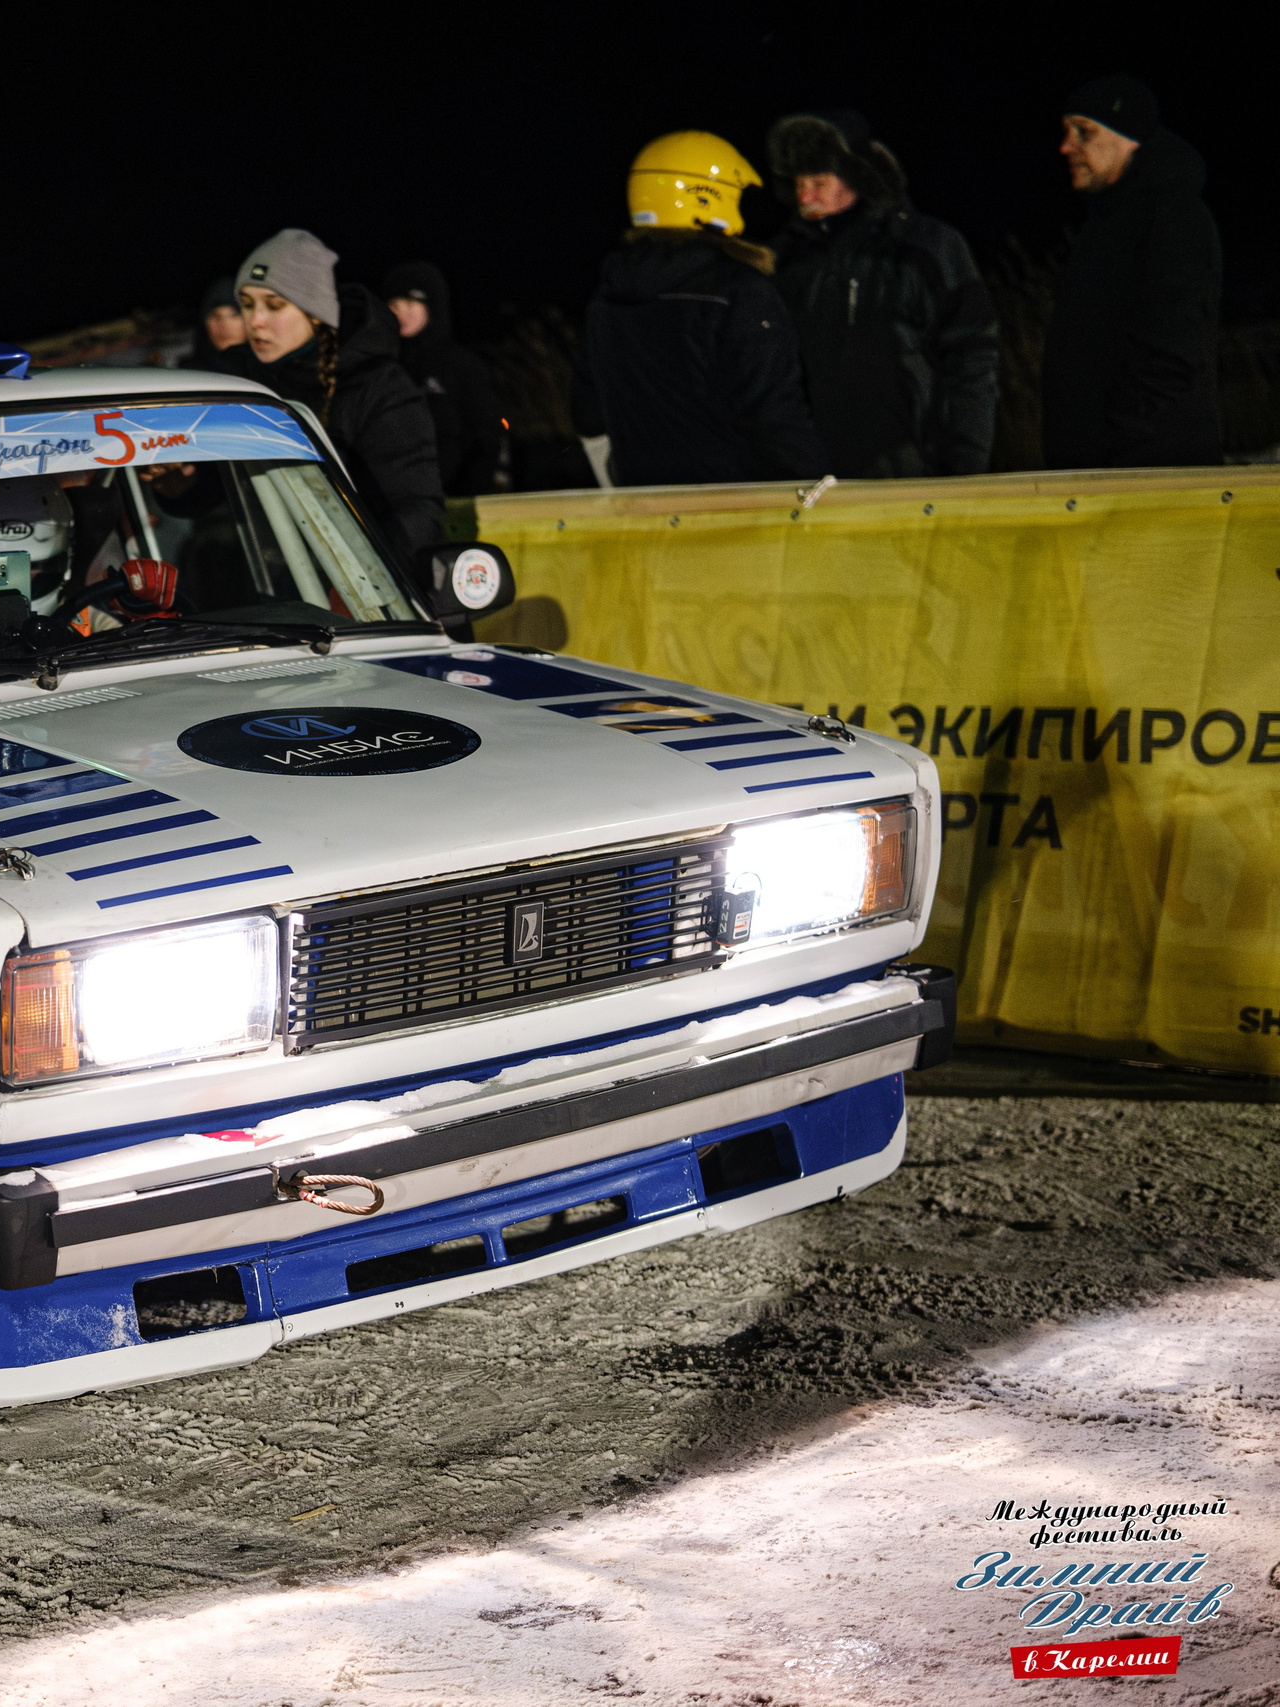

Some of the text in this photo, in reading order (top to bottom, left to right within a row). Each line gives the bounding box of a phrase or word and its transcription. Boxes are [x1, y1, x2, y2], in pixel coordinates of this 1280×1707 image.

[94, 411, 136, 466] 5
[142, 432, 190, 450] лет
[264, 731, 435, 765] ИНБИС
